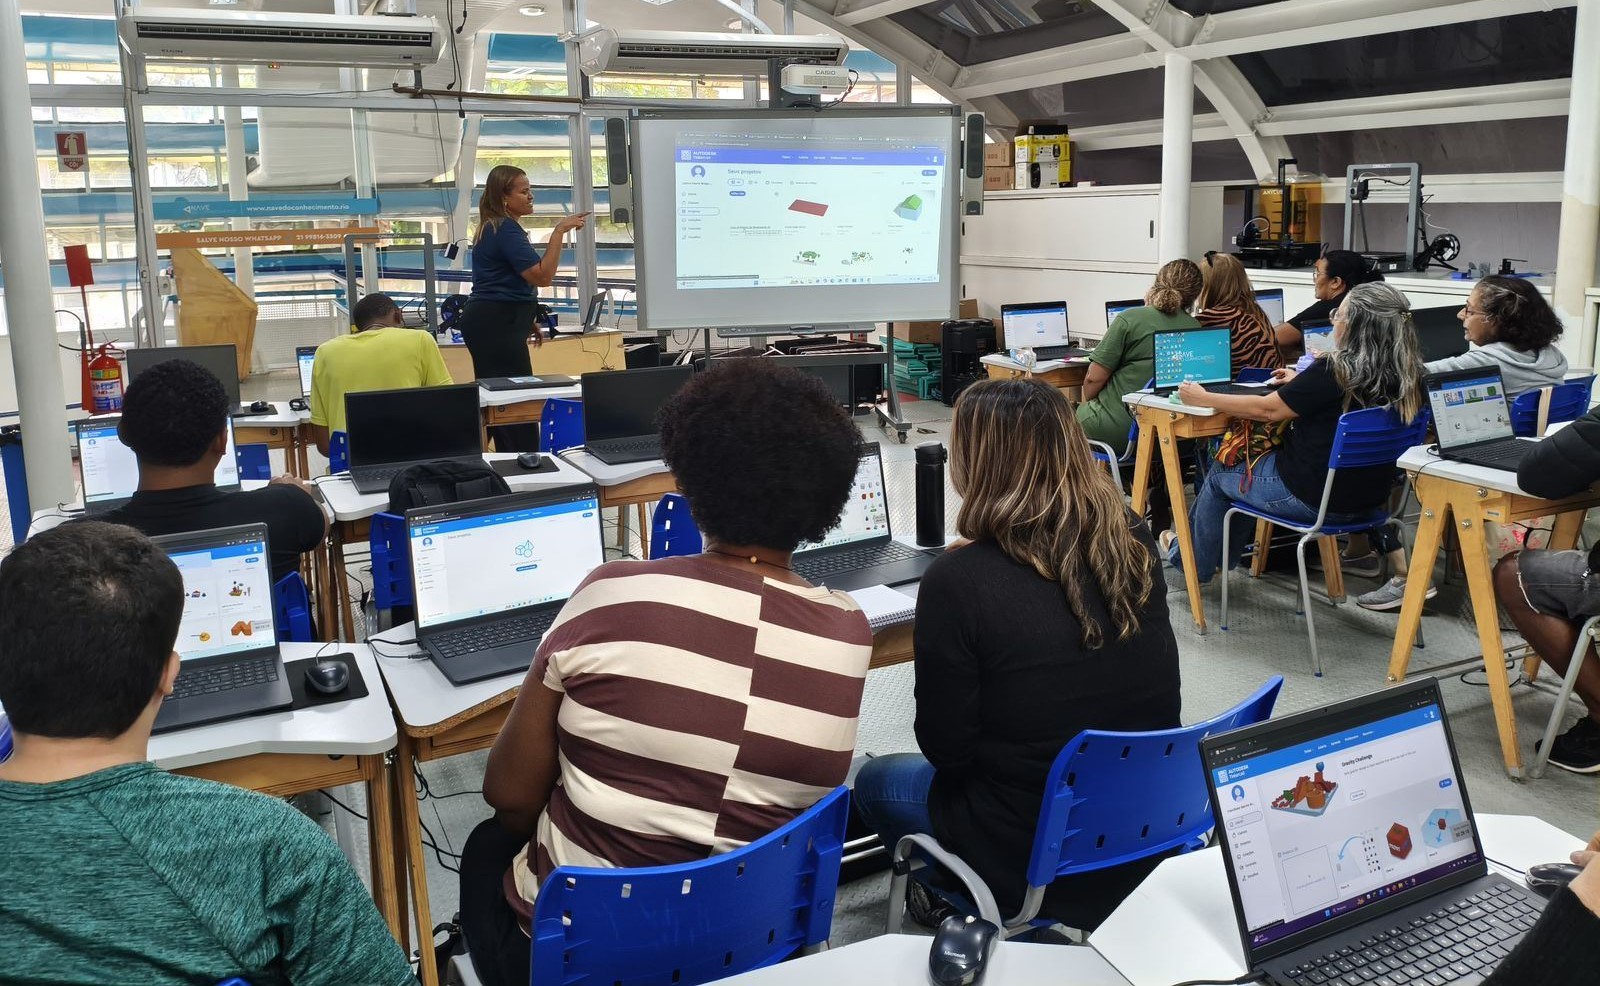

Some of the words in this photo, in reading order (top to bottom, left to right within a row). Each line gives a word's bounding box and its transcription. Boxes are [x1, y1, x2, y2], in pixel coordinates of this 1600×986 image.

[247, 203, 350, 212] www.navedoconhecimento.rio
[1355, 754, 1373, 763] Challenge
[944, 950, 966, 959] Microsoft
